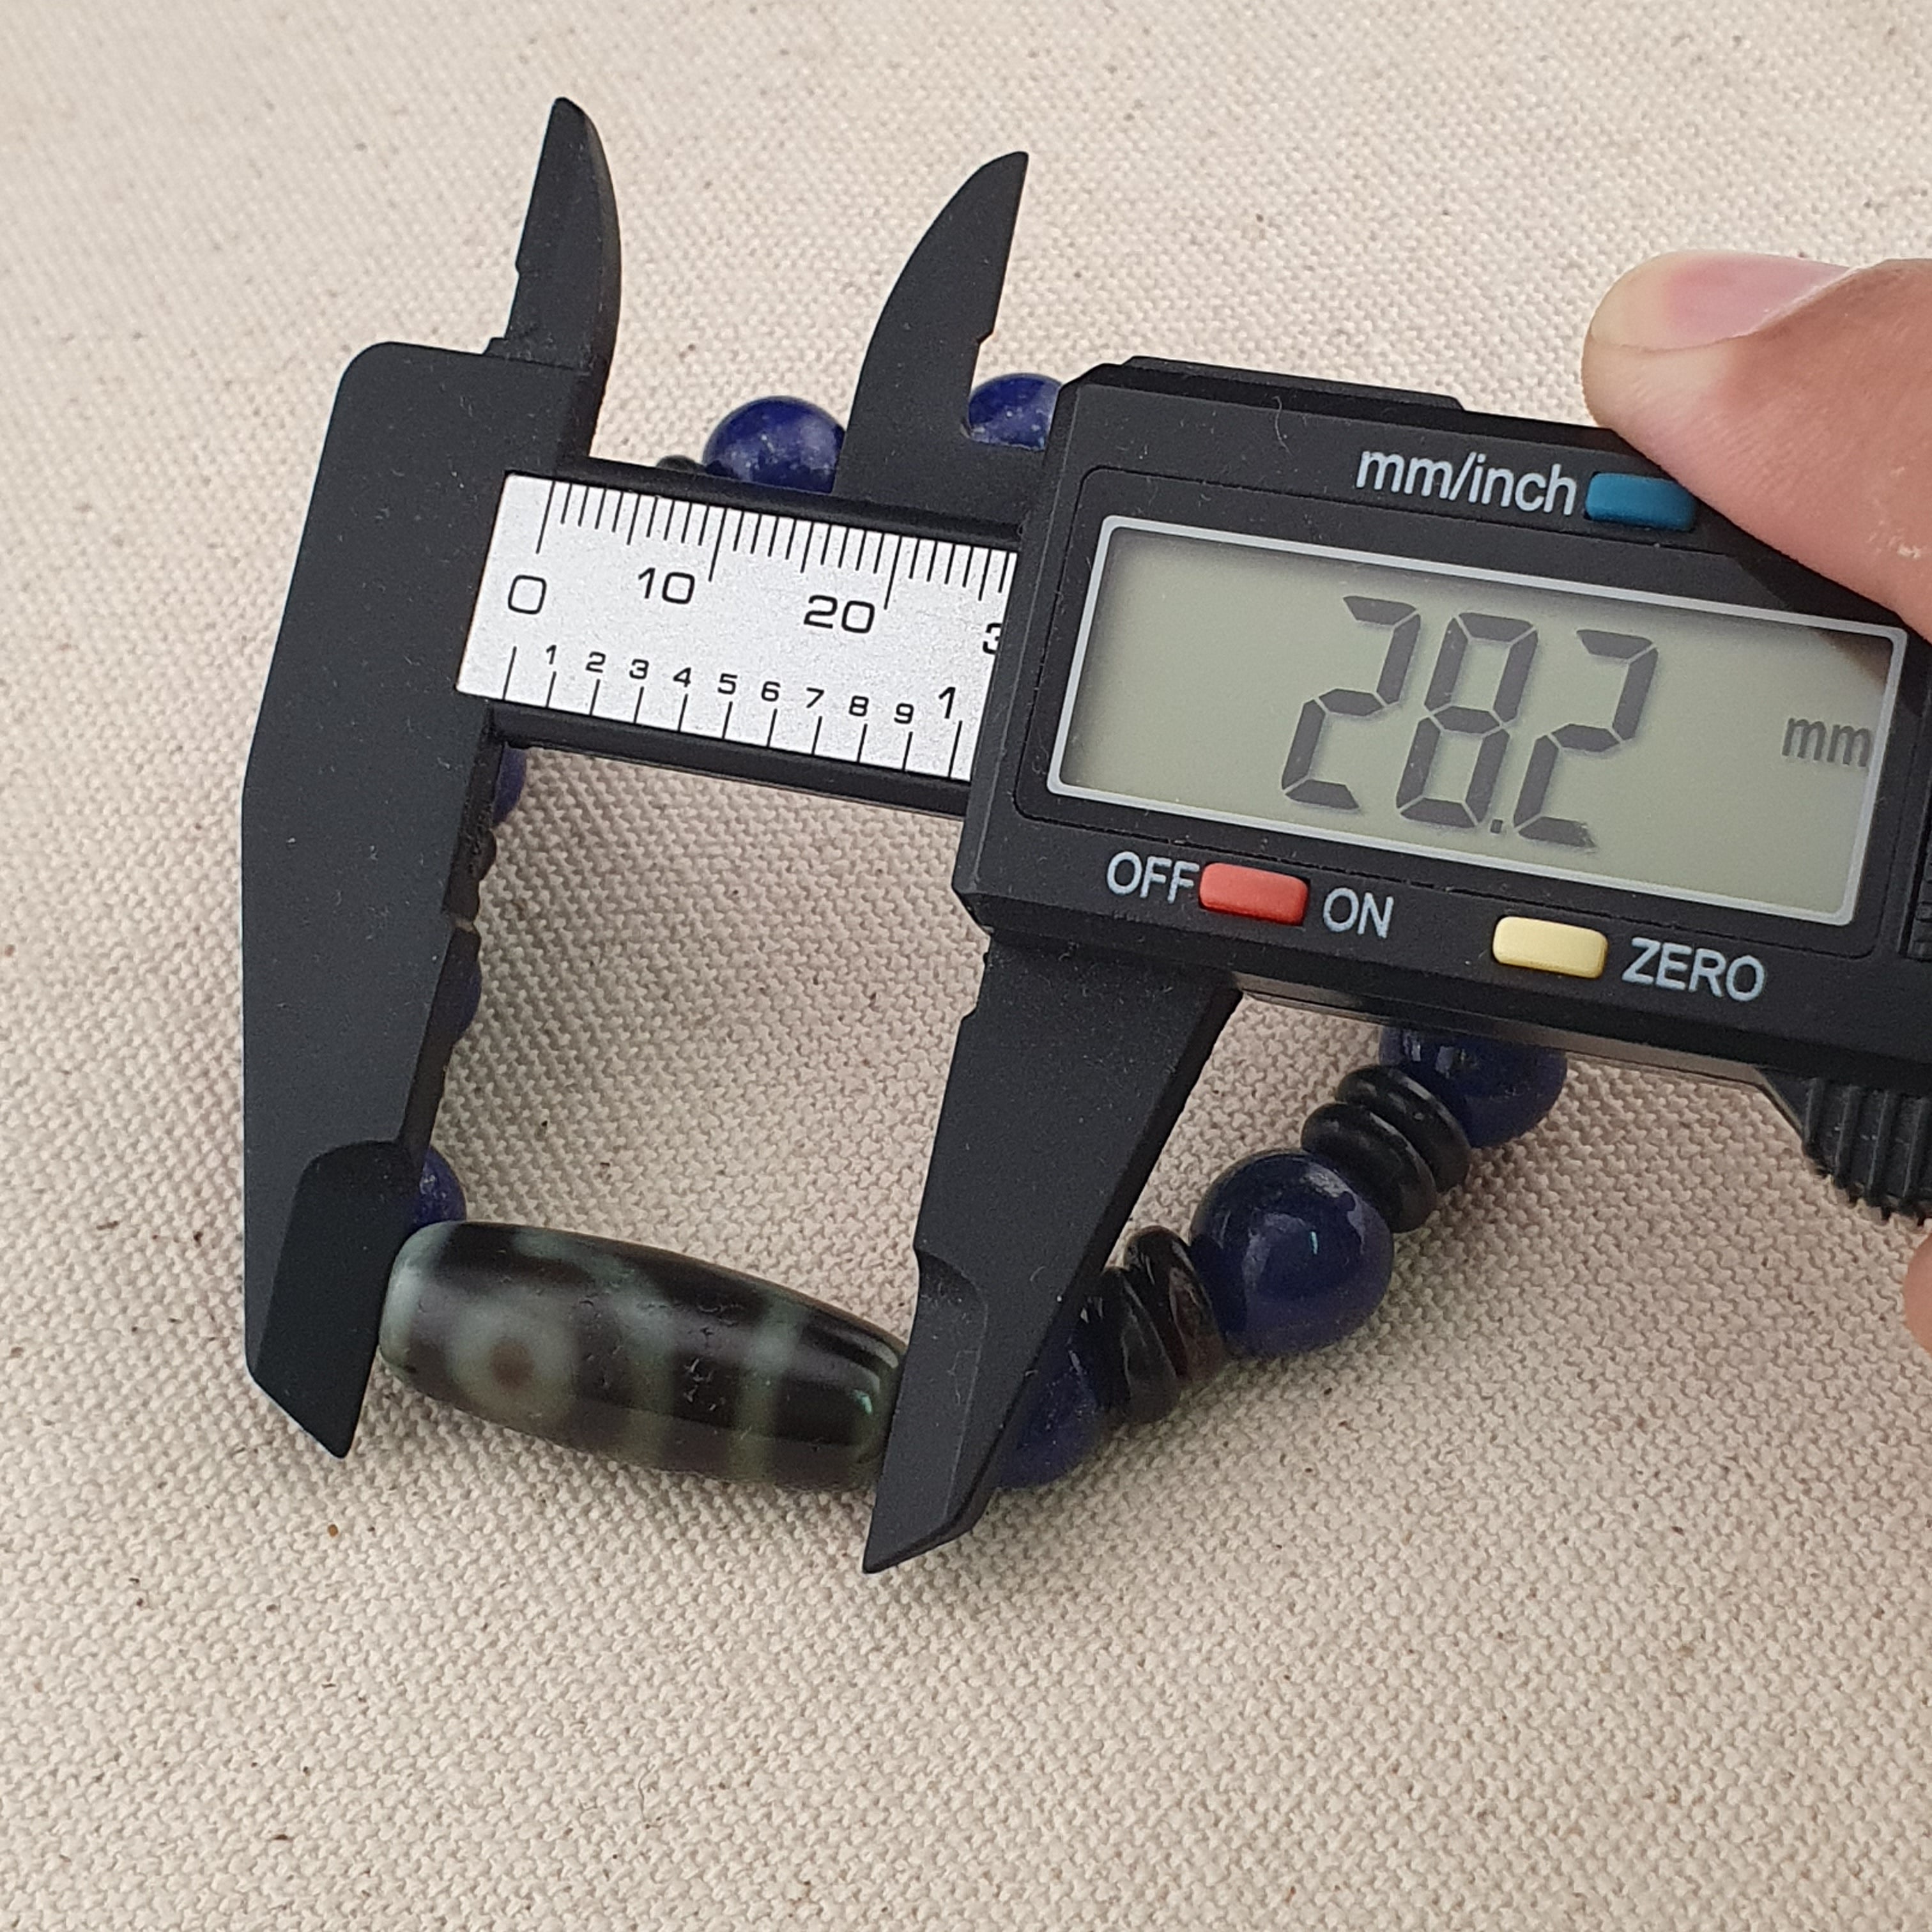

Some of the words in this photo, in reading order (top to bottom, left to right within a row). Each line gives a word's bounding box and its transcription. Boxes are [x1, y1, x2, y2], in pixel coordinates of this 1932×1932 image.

[1356, 449, 1578, 516] mm/inch
[508, 574, 547, 615] 0
[638, 567, 695, 604] 10
[803, 594, 875, 634] 20
[545, 644, 558, 665] 1
[585, 651, 606, 673] 2
[629, 659, 650, 680] 3
[673, 666, 693, 687] 4
[717, 673, 738, 694] 5
[761, 681, 781, 702] 6
[805, 687, 825, 709] 7
[849, 696, 869, 717] 8
[894, 703, 914, 724] 9
[939, 686, 958, 719] 1
[1280, 595, 1659, 851] 28.2
[1781, 716, 1873, 767] mm
[1107, 852, 1201, 903] OFF
[1322, 887, 1395, 938] ON
[1623, 937, 1766, 1000] ZERO
